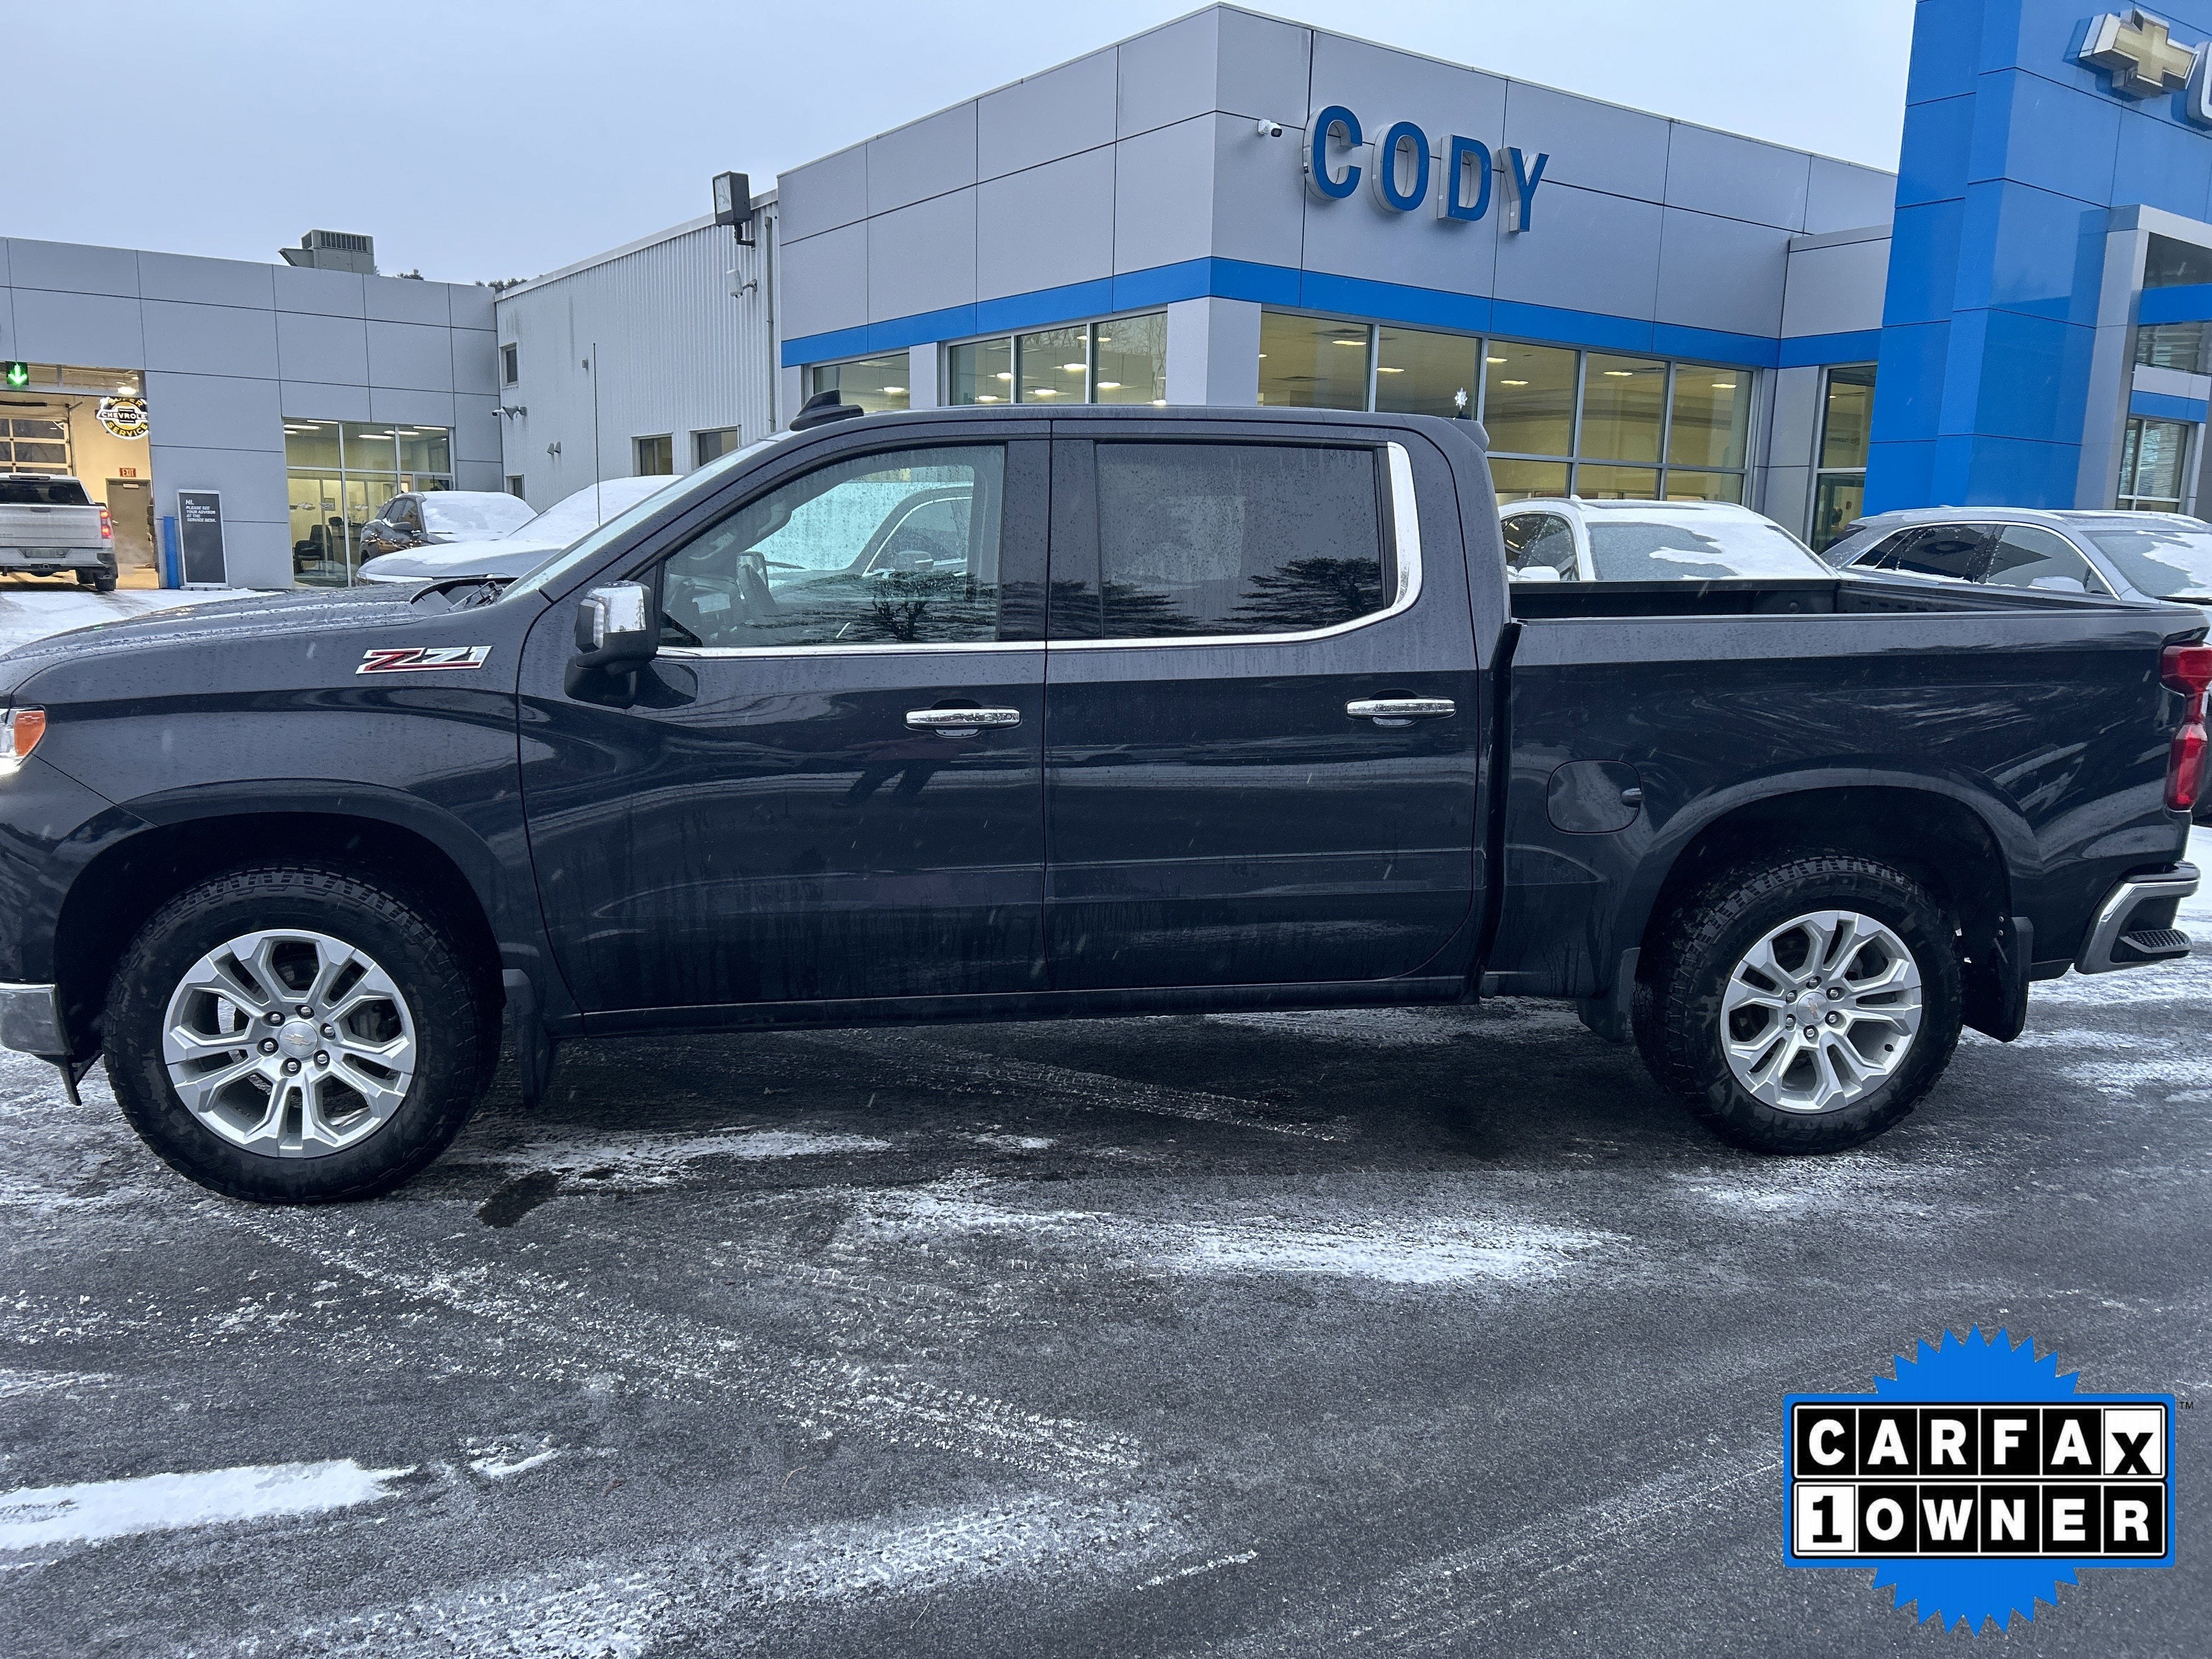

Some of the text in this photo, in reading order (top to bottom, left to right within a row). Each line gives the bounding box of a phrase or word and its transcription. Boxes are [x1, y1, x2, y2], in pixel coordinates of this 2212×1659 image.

[1304, 105, 1549, 233] CODY
[107, 421, 148, 437] SERVICE
[122, 469, 134, 477] EXIT
[356, 645, 493, 674] Z71
